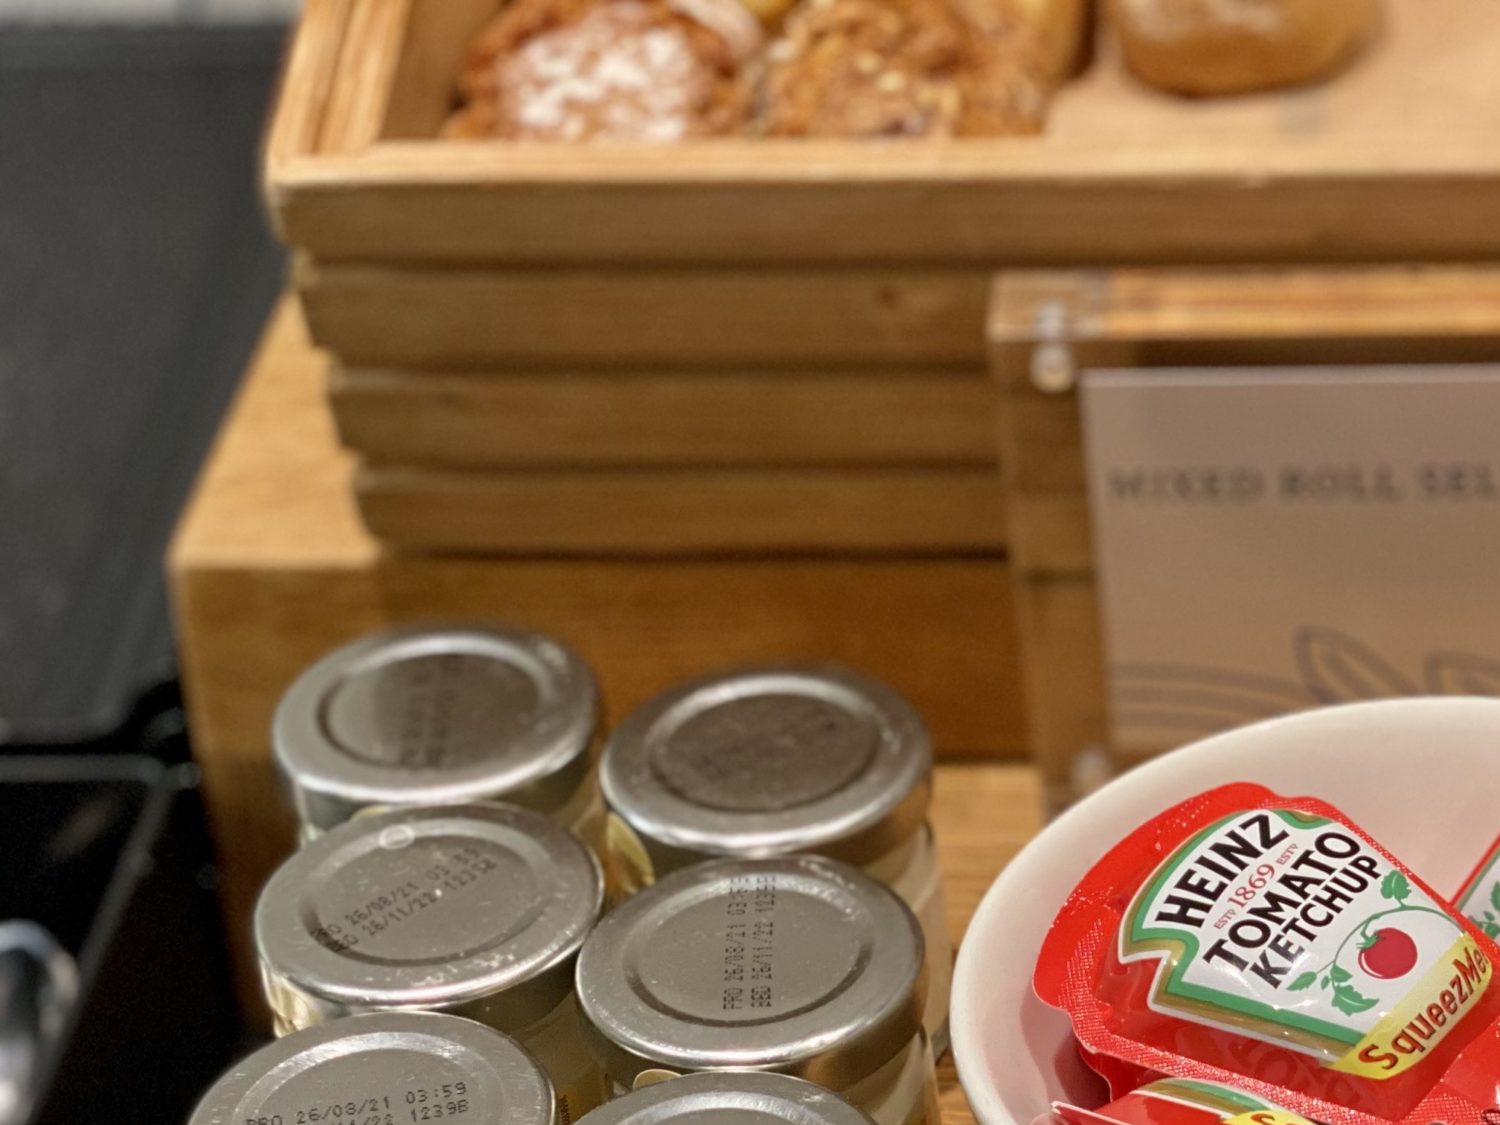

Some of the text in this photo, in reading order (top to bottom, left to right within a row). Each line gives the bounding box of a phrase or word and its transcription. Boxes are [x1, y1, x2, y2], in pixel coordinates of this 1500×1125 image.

[1278, 464, 1401, 504] ROLL
[1155, 814, 1290, 928] HEINZ
[1202, 832, 1361, 972] TOMATO
[1227, 864, 1276, 909] 1869
[1250, 856, 1382, 990] KETCHUP
[405, 1082, 467, 1104] 03:59
